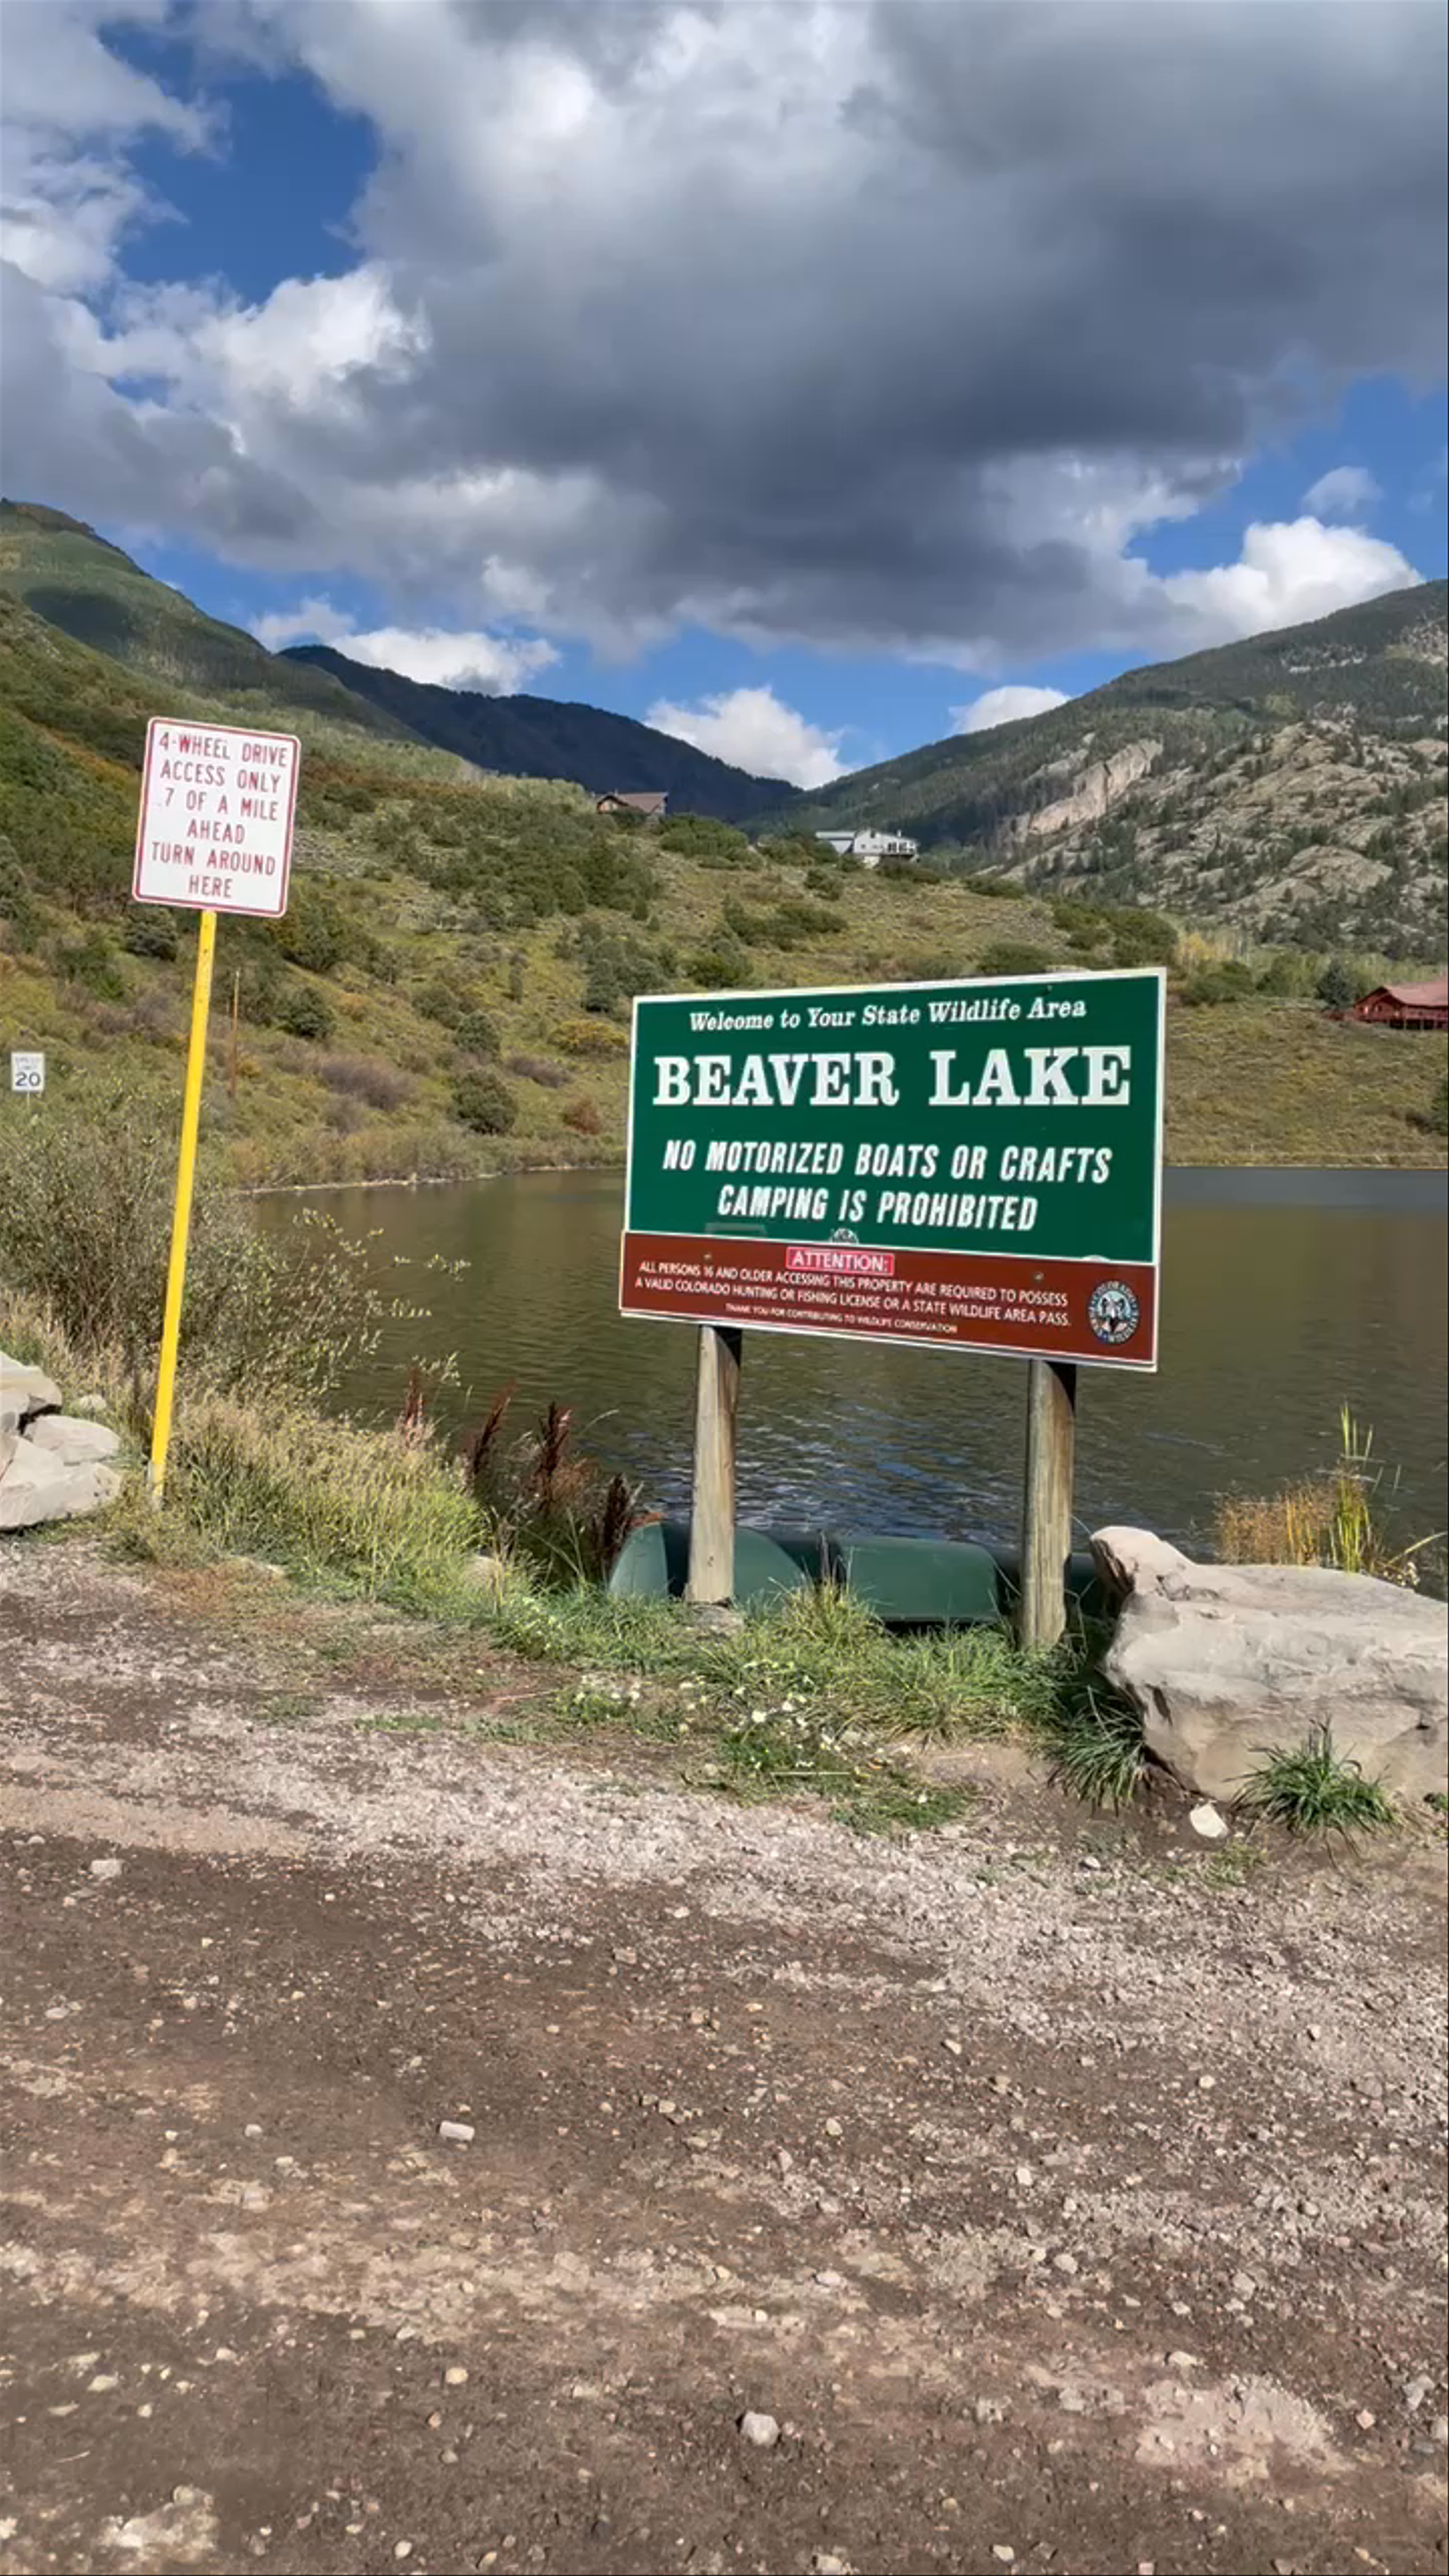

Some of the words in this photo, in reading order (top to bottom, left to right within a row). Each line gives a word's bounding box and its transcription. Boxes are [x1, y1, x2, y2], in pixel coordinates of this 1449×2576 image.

[158, 732, 231, 760] 4-WHEEL
[242, 743, 287, 767] DRIVE
[160, 760, 225, 786] ACCESS
[237, 769, 281, 793] ONLY
[186, 790, 207, 810] OF
[218, 795, 228, 814] A
[241, 798, 278, 820] MILE
[187, 818, 245, 844] AHEAD
[152, 842, 195, 865] TURN
[208, 849, 275, 875] AROUND
[189, 875, 232, 898] HERE
[689, 1011, 774, 1031] Welcome
[780, 1009, 801, 1029] to
[808, 1007, 855, 1028] Your
[861, 1004, 920, 1025] State
[928, 998, 1020, 1023] Wildlife
[1027, 997, 1086, 1019] Area
[15, 1071, 41, 1086] 20
[653, 1052, 900, 1107] BEAVER
[929, 1046, 1131, 1107] LAKE
[663, 1140, 696, 1170] NO
[705, 1141, 843, 1175] MOTORIZED
[854, 1144, 939, 1178] BOATS
[951, 1145, 987, 1180] OR
[1000, 1146, 1113, 1183] CRAFTS
[717, 1184, 829, 1220] CAMPING
[838, 1190, 867, 1223] IS
[877, 1191, 1038, 1230] PROHIBITED
[793, 1250, 888, 1272] ATTENTION:
[640, 1261, 655, 1273] ALL
[659, 1263, 700, 1276] PERSONS
[704, 1266, 714, 1276] 16
[717, 1267, 738, 1279] AND
[740, 1269, 772, 1281] OLDER
[776, 1272, 829, 1286] ACCESSING
[834, 1275, 855, 1288] THIS
[858, 1278, 911, 1293] PROPERTY
[915, 1283, 936, 1296] ARE
[941, 1284, 996, 1301] REQUIRED
[1001, 1289, 1015, 1302] TO
[1019, 1291, 1068, 1307] POSSESS
[635, 1278, 643, 1288] A
[645, 1279, 674, 1290] VALID
[675, 1280, 730, 1295] COLORADO
[732, 1285, 778, 1300] HUNTING
[780, 1288, 794, 1301] OR
[798, 1289, 837, 1304] FISHING
[840, 1294, 879, 1308] LICENSE
[883, 1296, 899, 1309] OR
[902, 1299, 911, 1310] A
[914, 1300, 946, 1314] STATE
[949, 1304, 1001, 1320] WILDLIFE
[1004, 1309, 1035, 1323] AREA
[1039, 1312, 1071, 1326] PASS.
